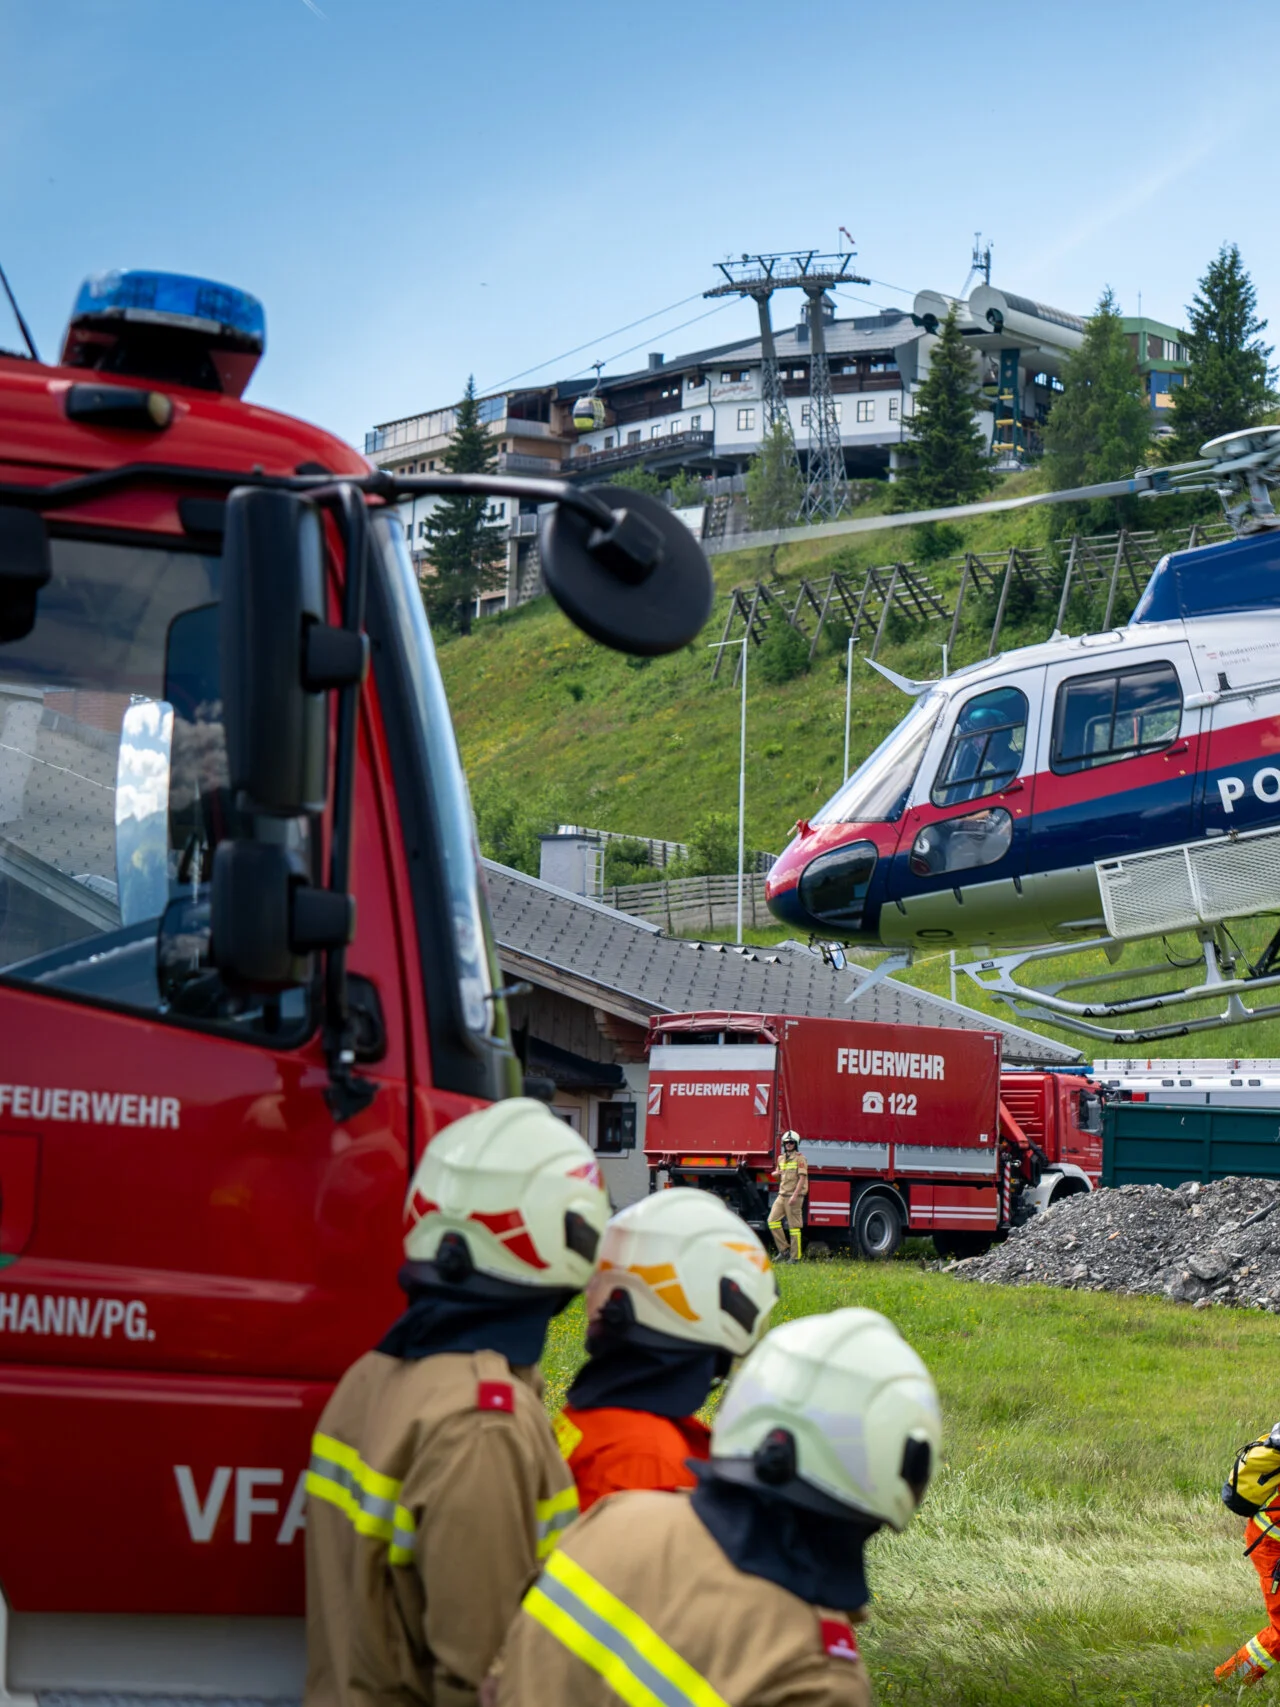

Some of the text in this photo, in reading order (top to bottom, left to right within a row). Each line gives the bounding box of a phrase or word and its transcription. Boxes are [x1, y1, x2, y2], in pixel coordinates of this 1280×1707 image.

[837, 1048, 945, 1080] FEUERWEHR
[669, 1083, 750, 1096] FEUERWEHR
[0, 1083, 181, 1130] FEUERWEHR
[888, 1093, 917, 1116] 122
